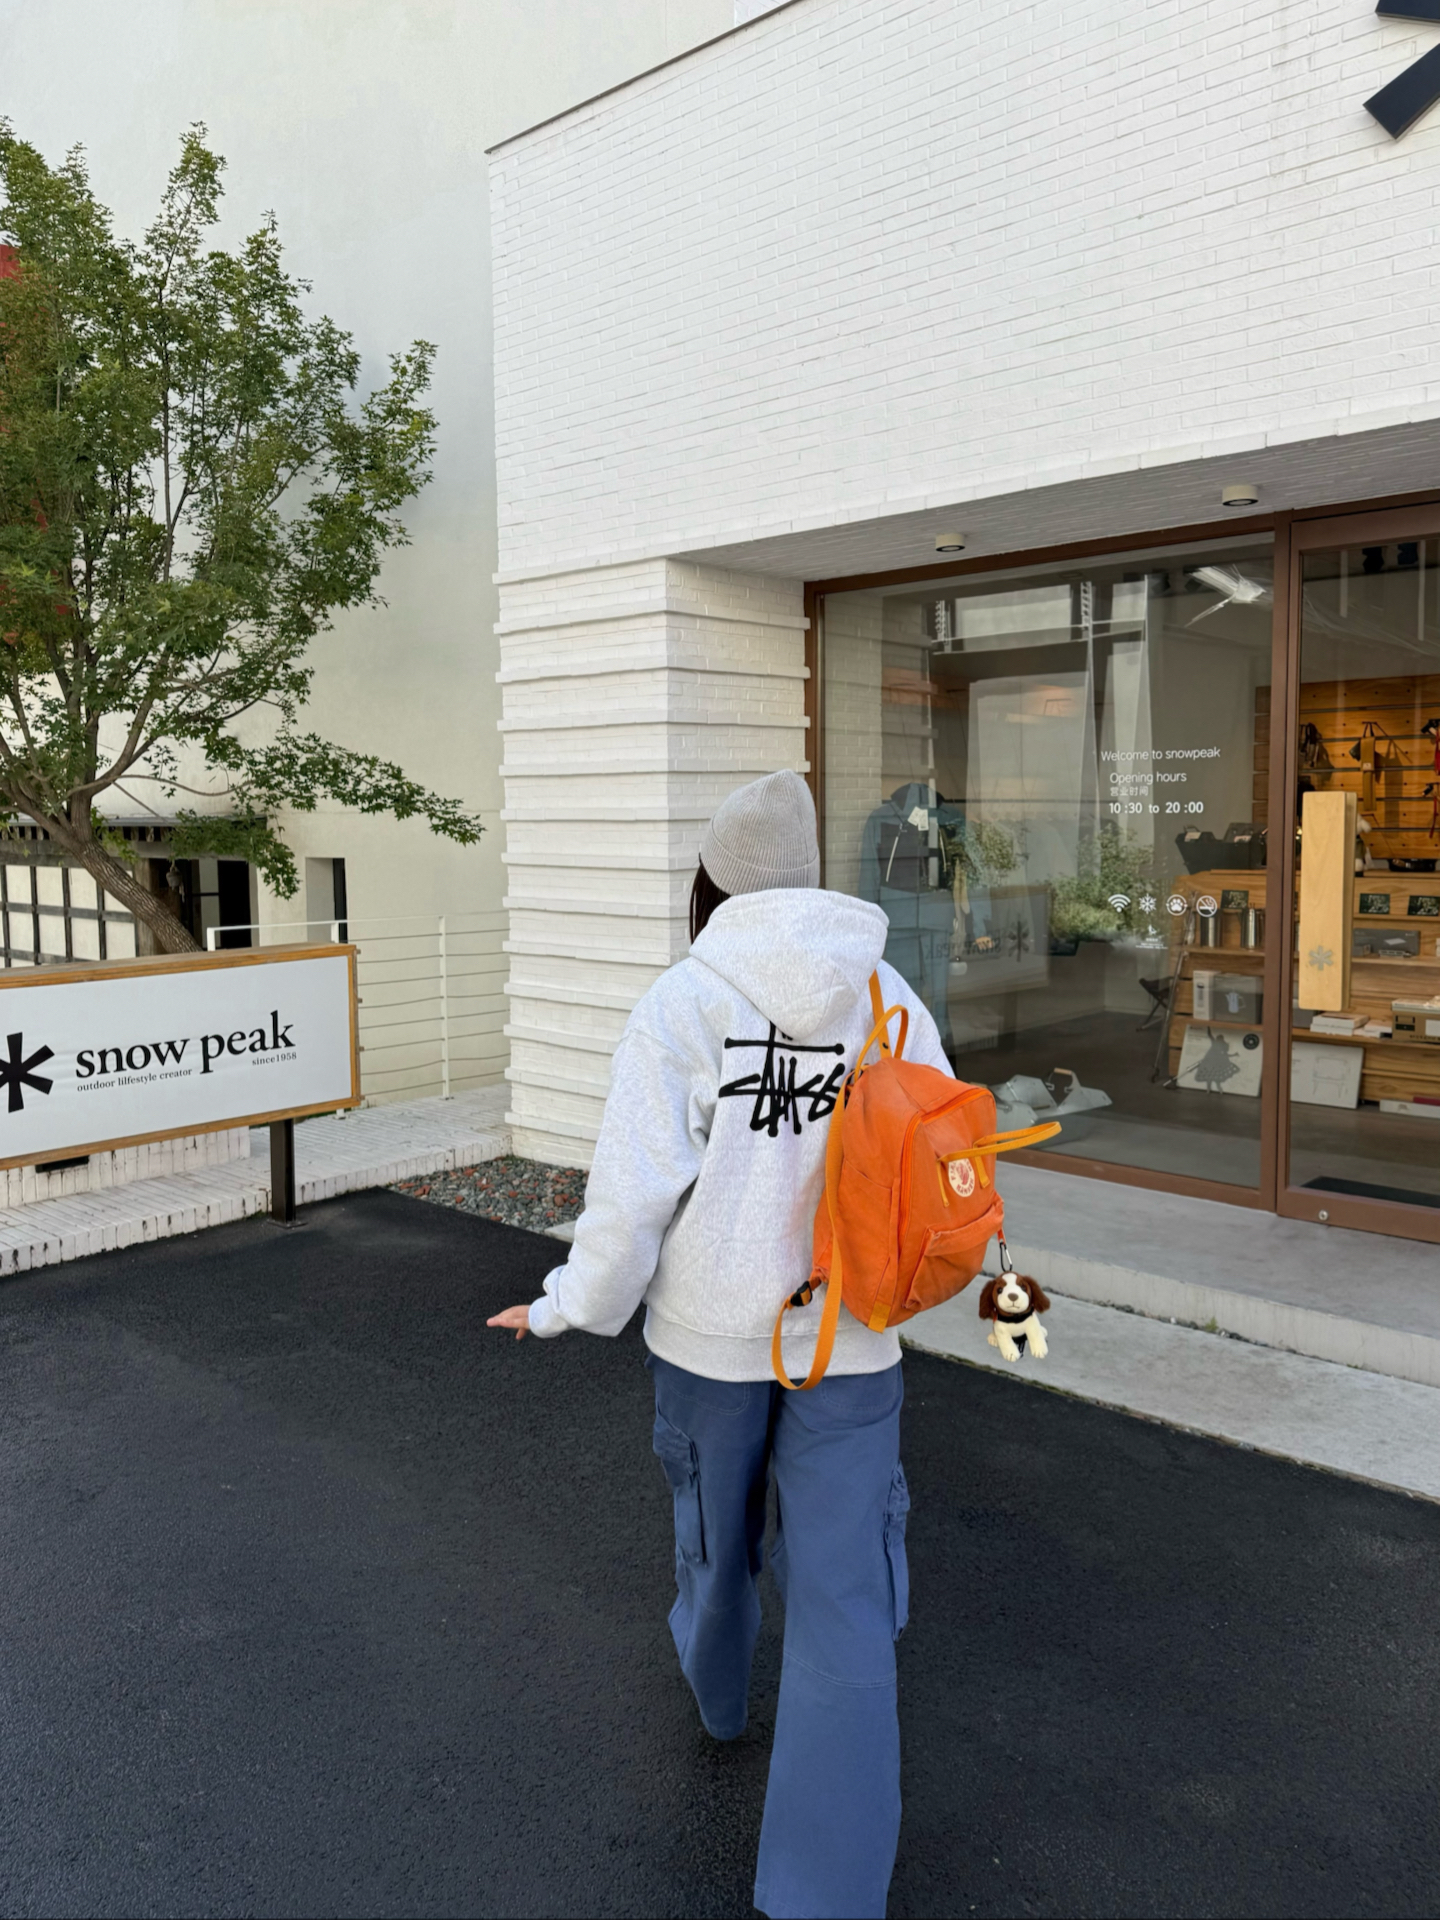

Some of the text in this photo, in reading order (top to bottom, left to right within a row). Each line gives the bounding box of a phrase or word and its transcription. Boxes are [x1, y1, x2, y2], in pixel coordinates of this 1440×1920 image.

[1101, 746, 1220, 761] Welcome to snowpeak
[1109, 771, 1187, 786] Opening hours
[1110, 786, 1149, 797] 营业时间
[1149, 803, 1160, 813] to
[76, 1010, 296, 1078] snow peak
[251, 1051, 297, 1066] since1958
[77, 1067, 193, 1093] outdoor lilfestyle creator
